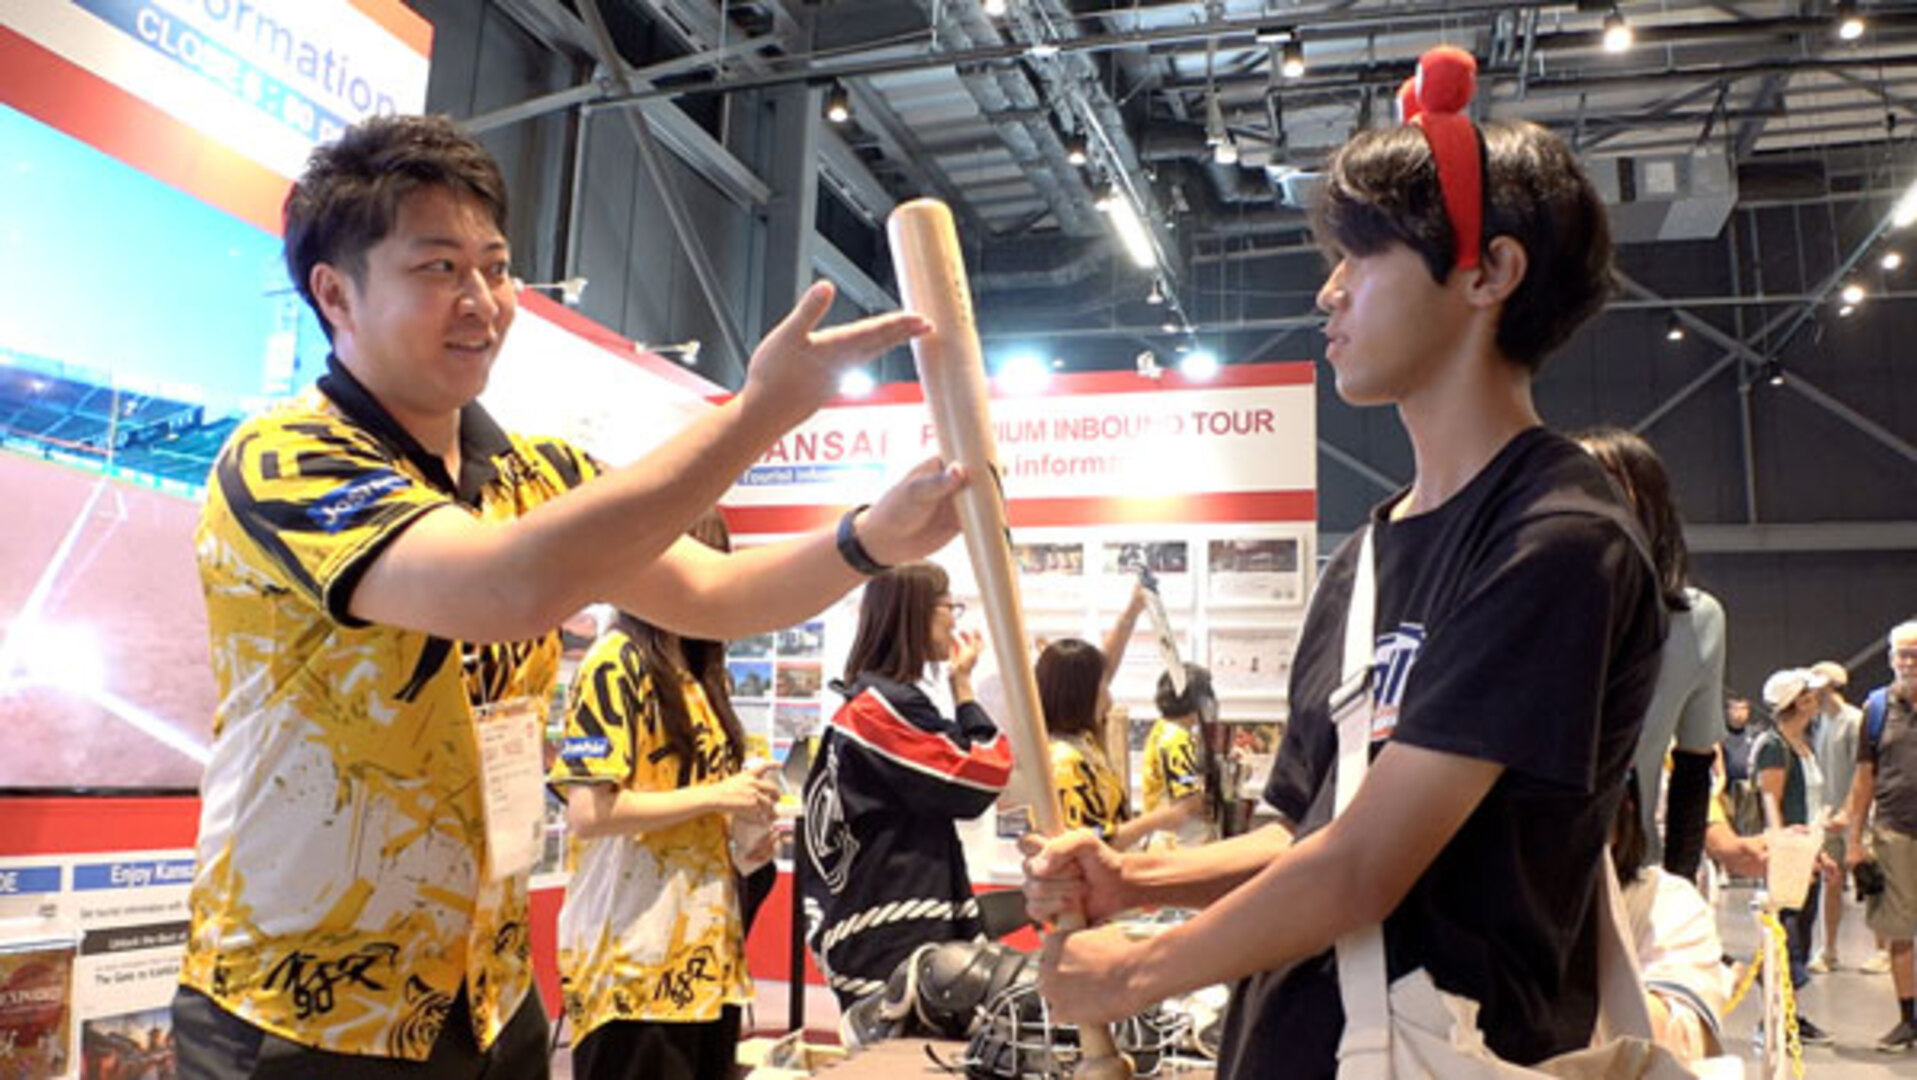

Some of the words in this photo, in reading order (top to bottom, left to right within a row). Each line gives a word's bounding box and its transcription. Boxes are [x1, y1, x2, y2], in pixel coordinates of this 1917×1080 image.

[186, 0, 397, 118] ormation
[920, 416, 1046, 447] PIUM
[1192, 408, 1275, 436] TOUR
[764, 429, 890, 463] ANSAI
[110, 864, 154, 887] Enjoy
